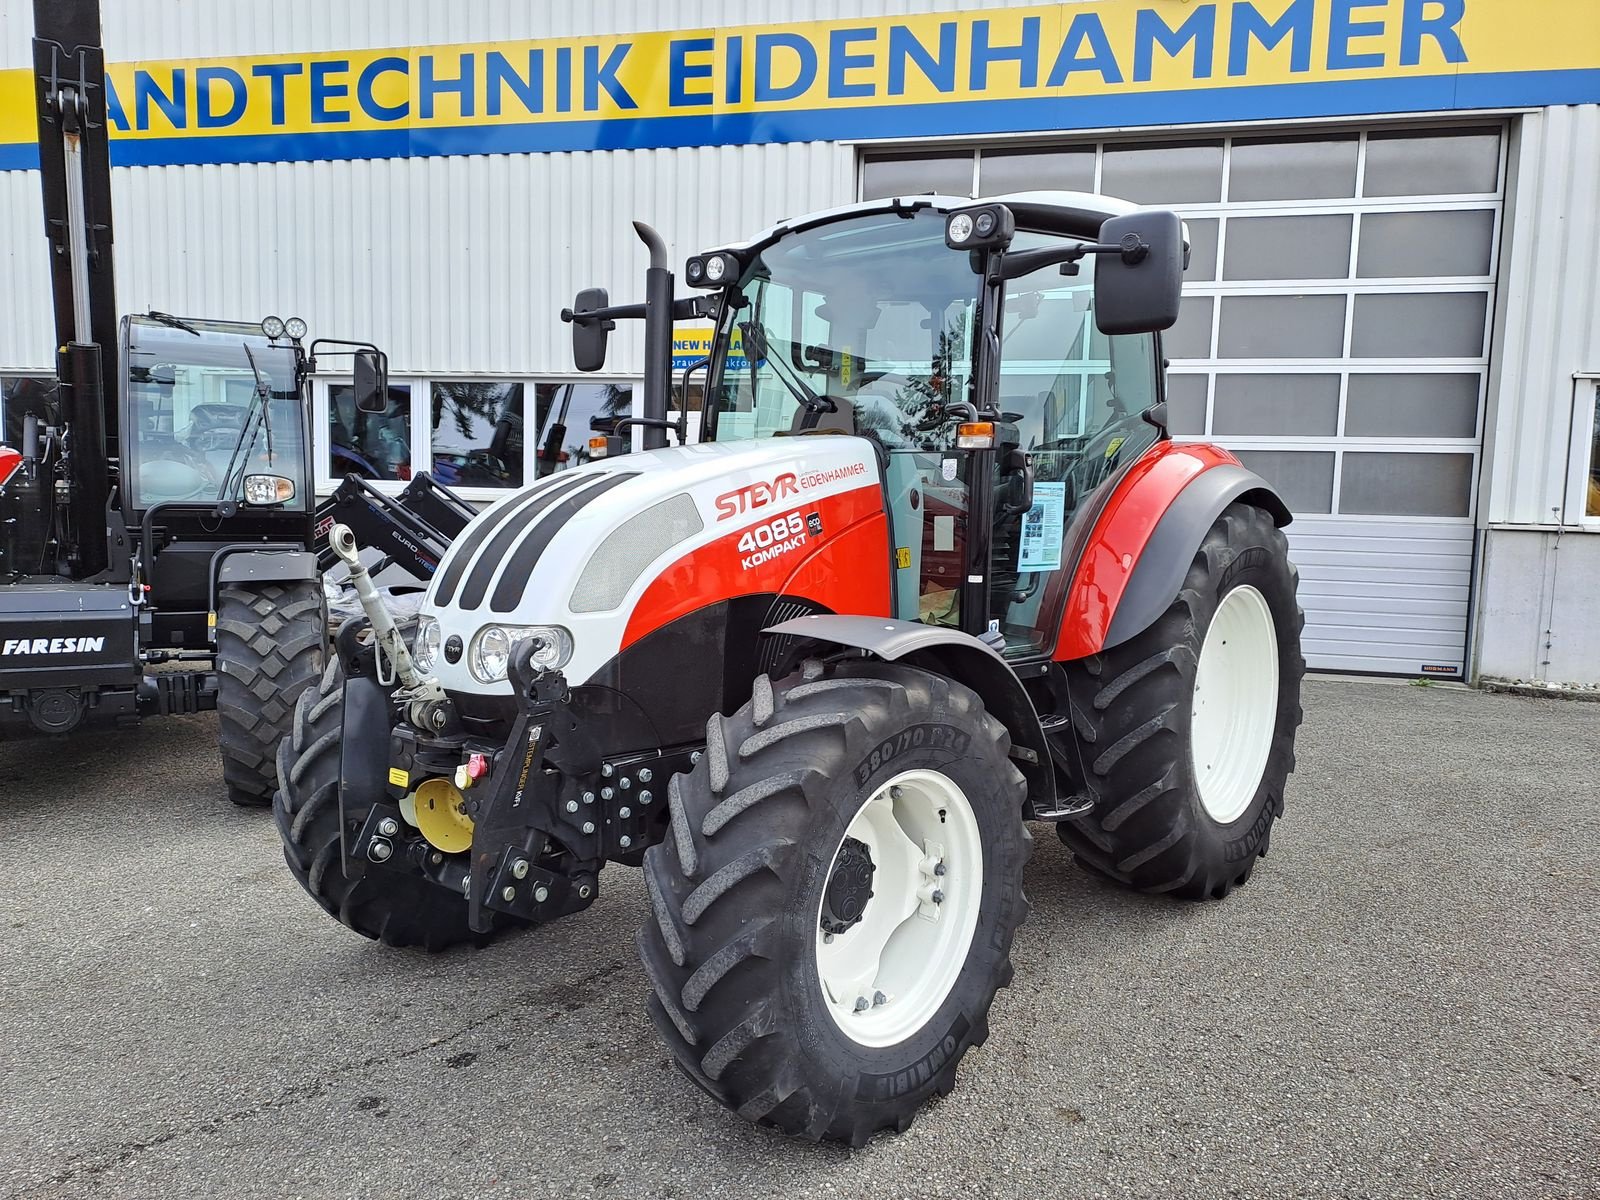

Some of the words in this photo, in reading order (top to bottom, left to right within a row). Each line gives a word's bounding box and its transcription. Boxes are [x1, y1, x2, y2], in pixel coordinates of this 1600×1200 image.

[669, 0, 1469, 107] EIDENHAMMER
[673, 340, 699, 351] NEW
[714, 472, 799, 522] STEYR
[737, 511, 804, 553] 4085
[741, 532, 806, 571] KOMPAKT
[1, 636, 105, 656] FARESIN
